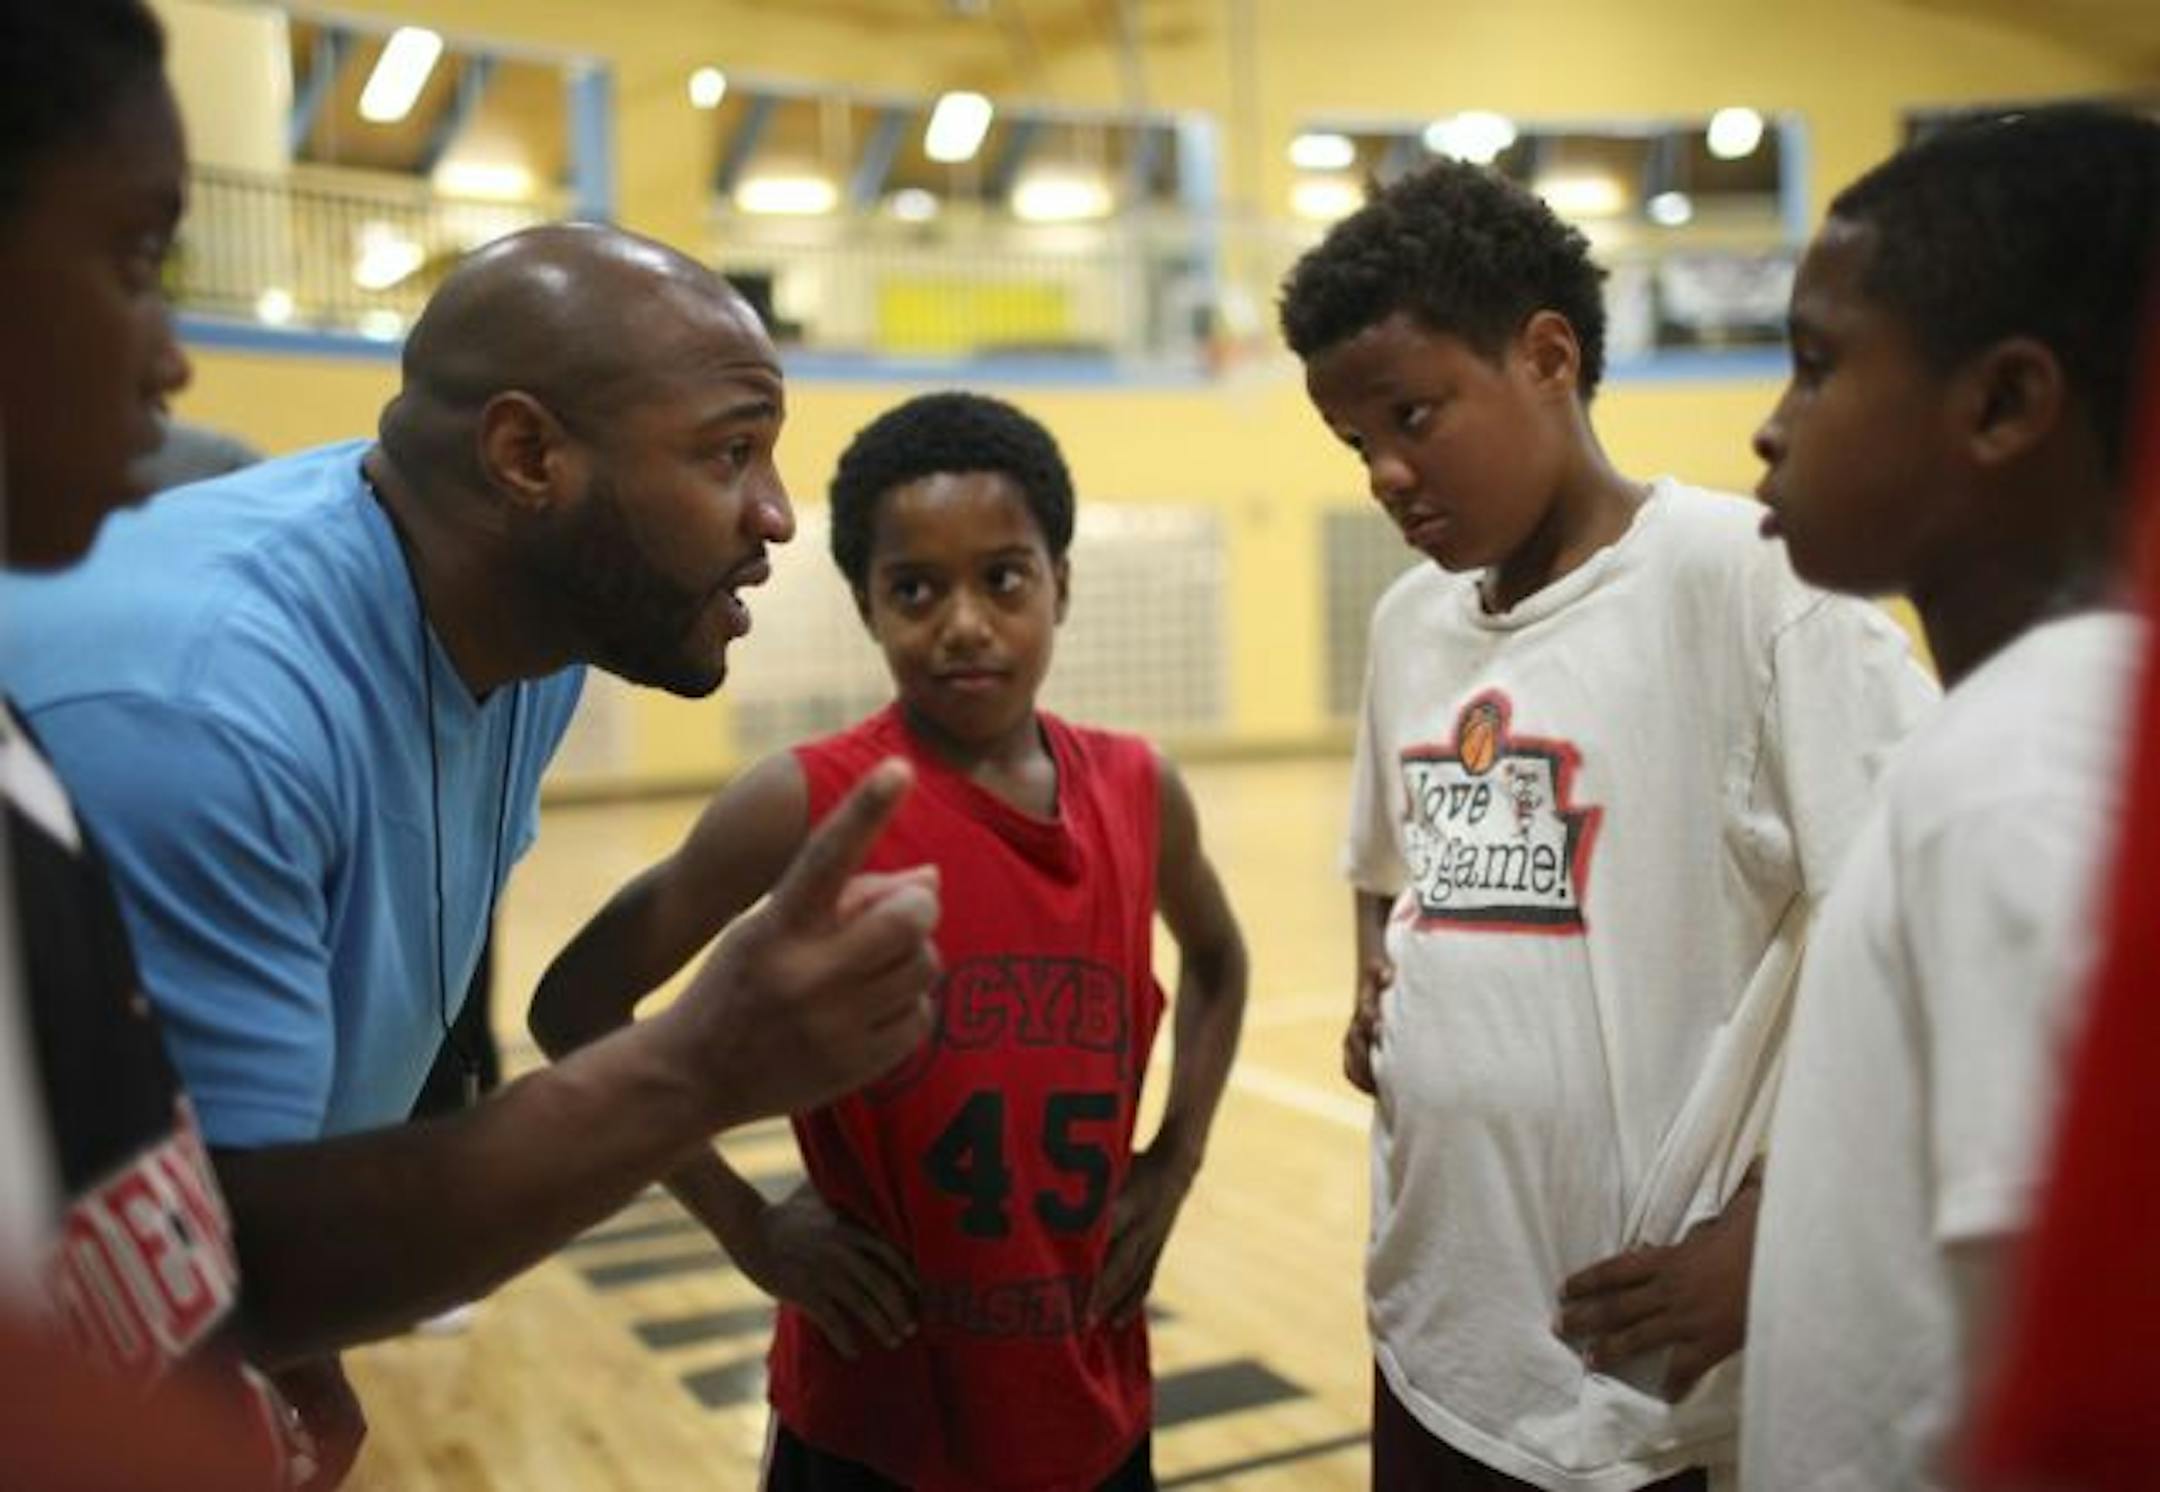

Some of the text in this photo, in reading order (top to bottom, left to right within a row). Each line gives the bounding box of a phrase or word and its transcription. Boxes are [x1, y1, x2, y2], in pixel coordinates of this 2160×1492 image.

[1431, 838, 1569, 901] game!
[930, 954, 1130, 1060] CYB
[922, 1090, 1120, 1239] 45
